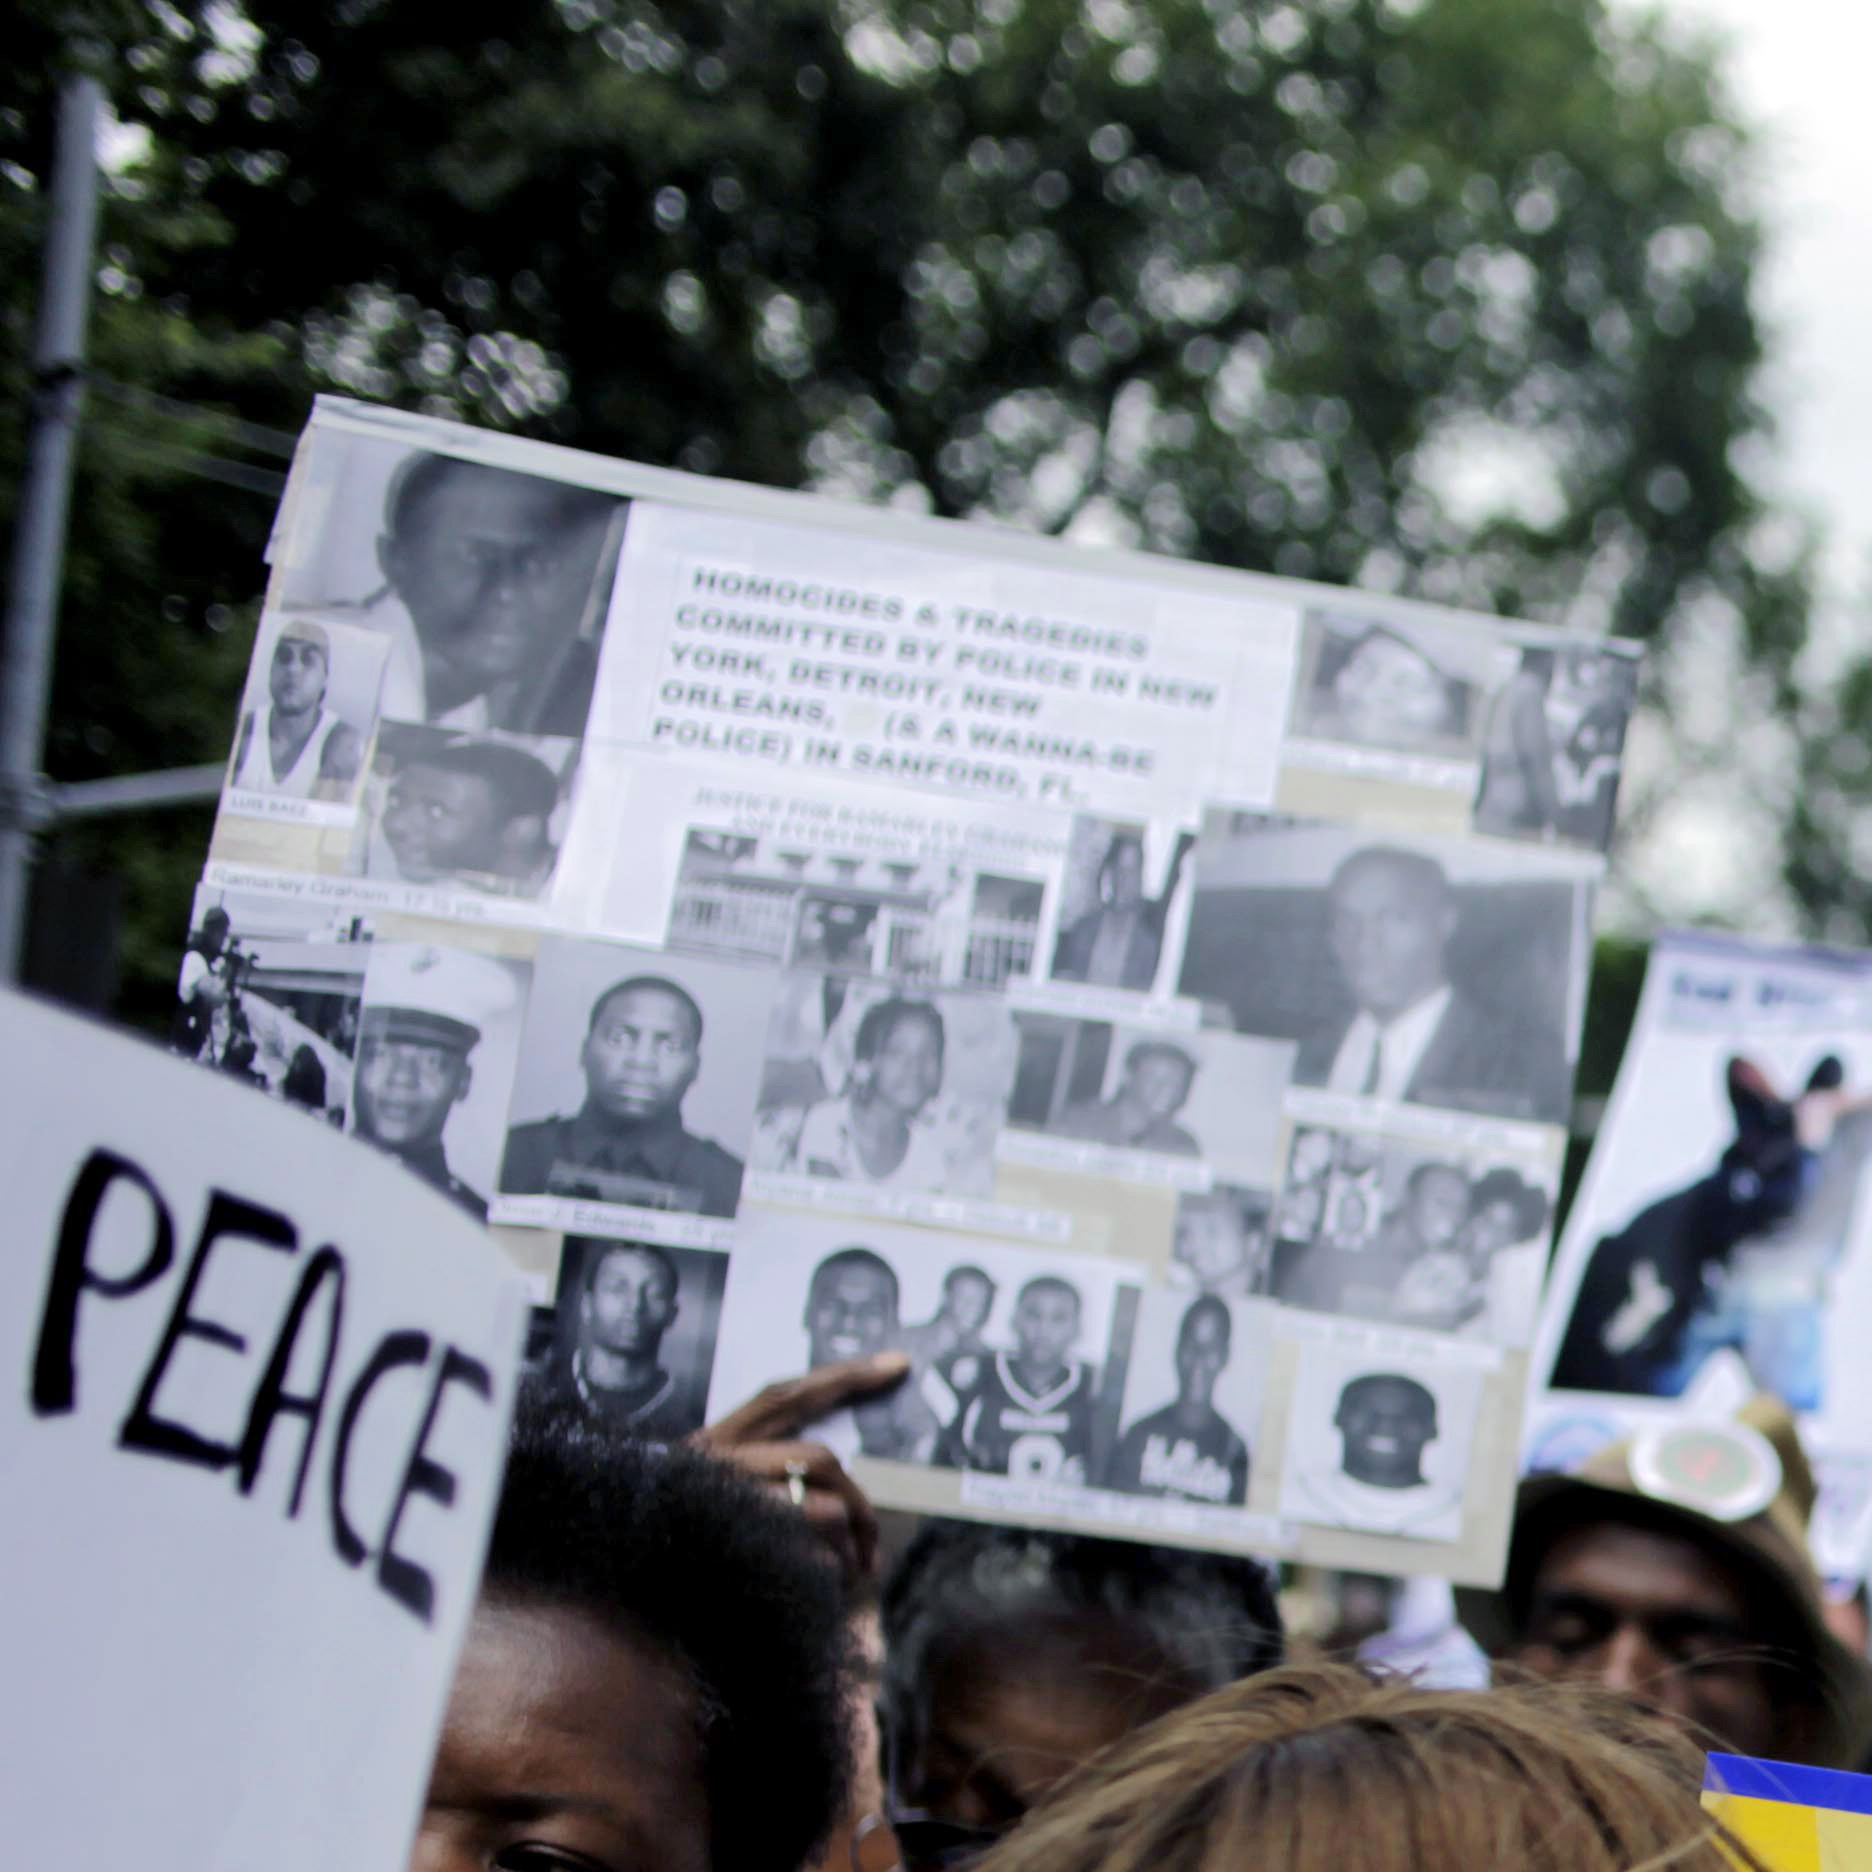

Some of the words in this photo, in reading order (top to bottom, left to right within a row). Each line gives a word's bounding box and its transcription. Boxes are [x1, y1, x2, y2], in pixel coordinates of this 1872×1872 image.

[676, 604, 886, 656] COMMITTED
[900, 633, 941, 663] BY
[954, 645, 1079, 685] POLICE
[1091, 666, 1126, 696] IN
[1138, 673, 1218, 709] NEW
[952, 606, 1149, 660] TRAGEDIES
[669, 643, 776, 684] YORK,
[788, 660, 952, 710] DETROIT,
[963, 684, 1043, 719] NEW
[652, 717, 792, 764] POLICE)
[804, 736, 840, 764] IN
[852, 745, 1027, 799] SANFORD,
[661, 680, 835, 733] ORLEANS,
[968, 723, 1157, 773] WANNA-BE
[28, 1146, 493, 1630] PEACE
